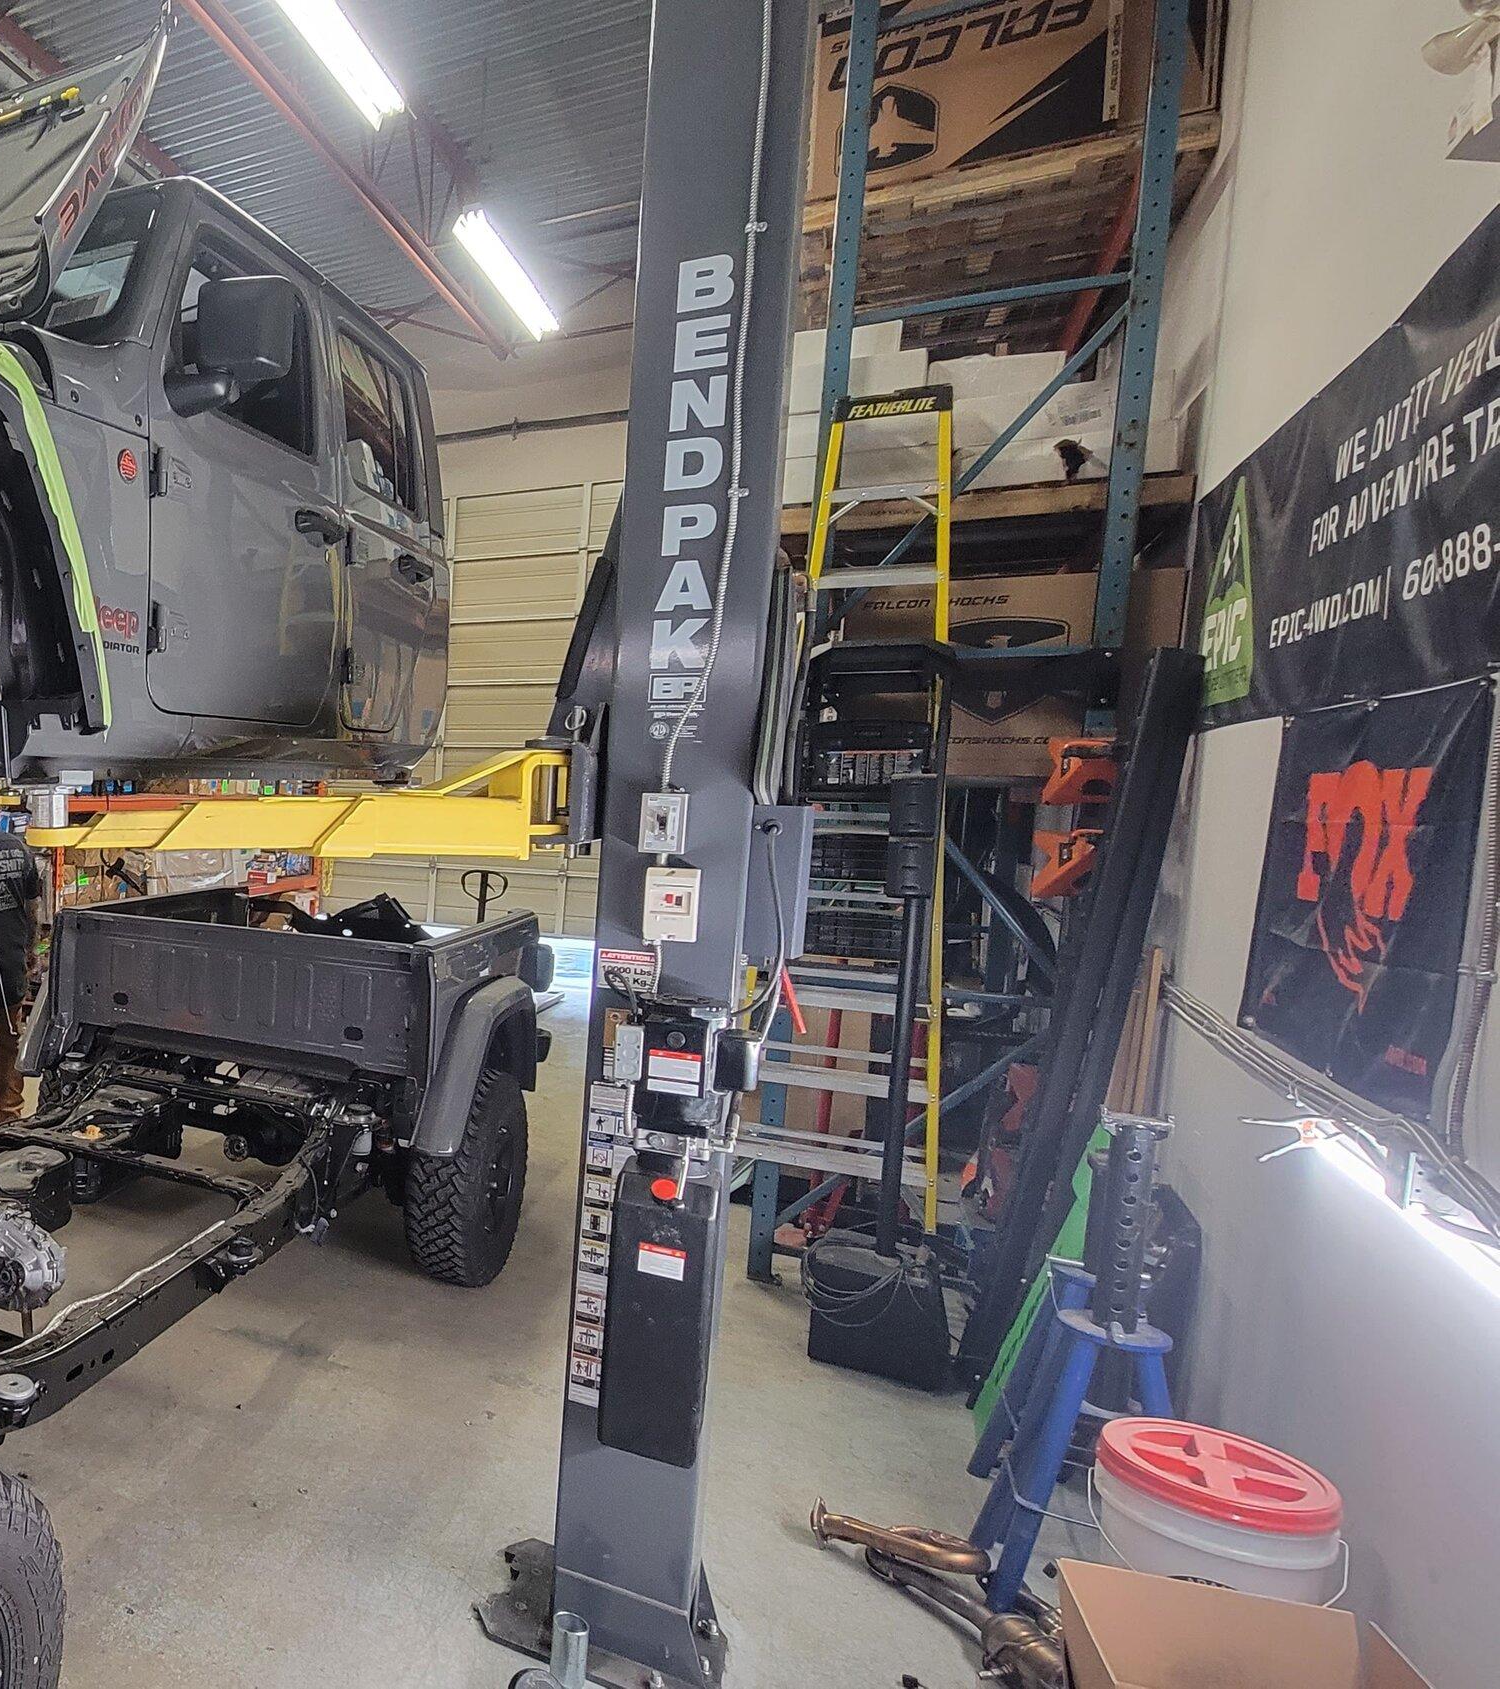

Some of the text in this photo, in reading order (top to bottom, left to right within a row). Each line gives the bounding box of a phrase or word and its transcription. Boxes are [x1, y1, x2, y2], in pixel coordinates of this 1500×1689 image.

[847, 396, 938, 419] FEATHERLITE
[650, 253, 735, 671] BENDPAK
[1335, 427, 1368, 483] WE
[1309, 504, 1340, 558] FOR
[97, 598, 140, 640] eep
[864, 595, 1010, 611] FALCON HOCKS
[102, 641, 140, 655] DIATOR
[1202, 597, 1247, 673] EPIC
[632, 977, 648, 988] Kg
[634, 967, 653, 977] Lbs
